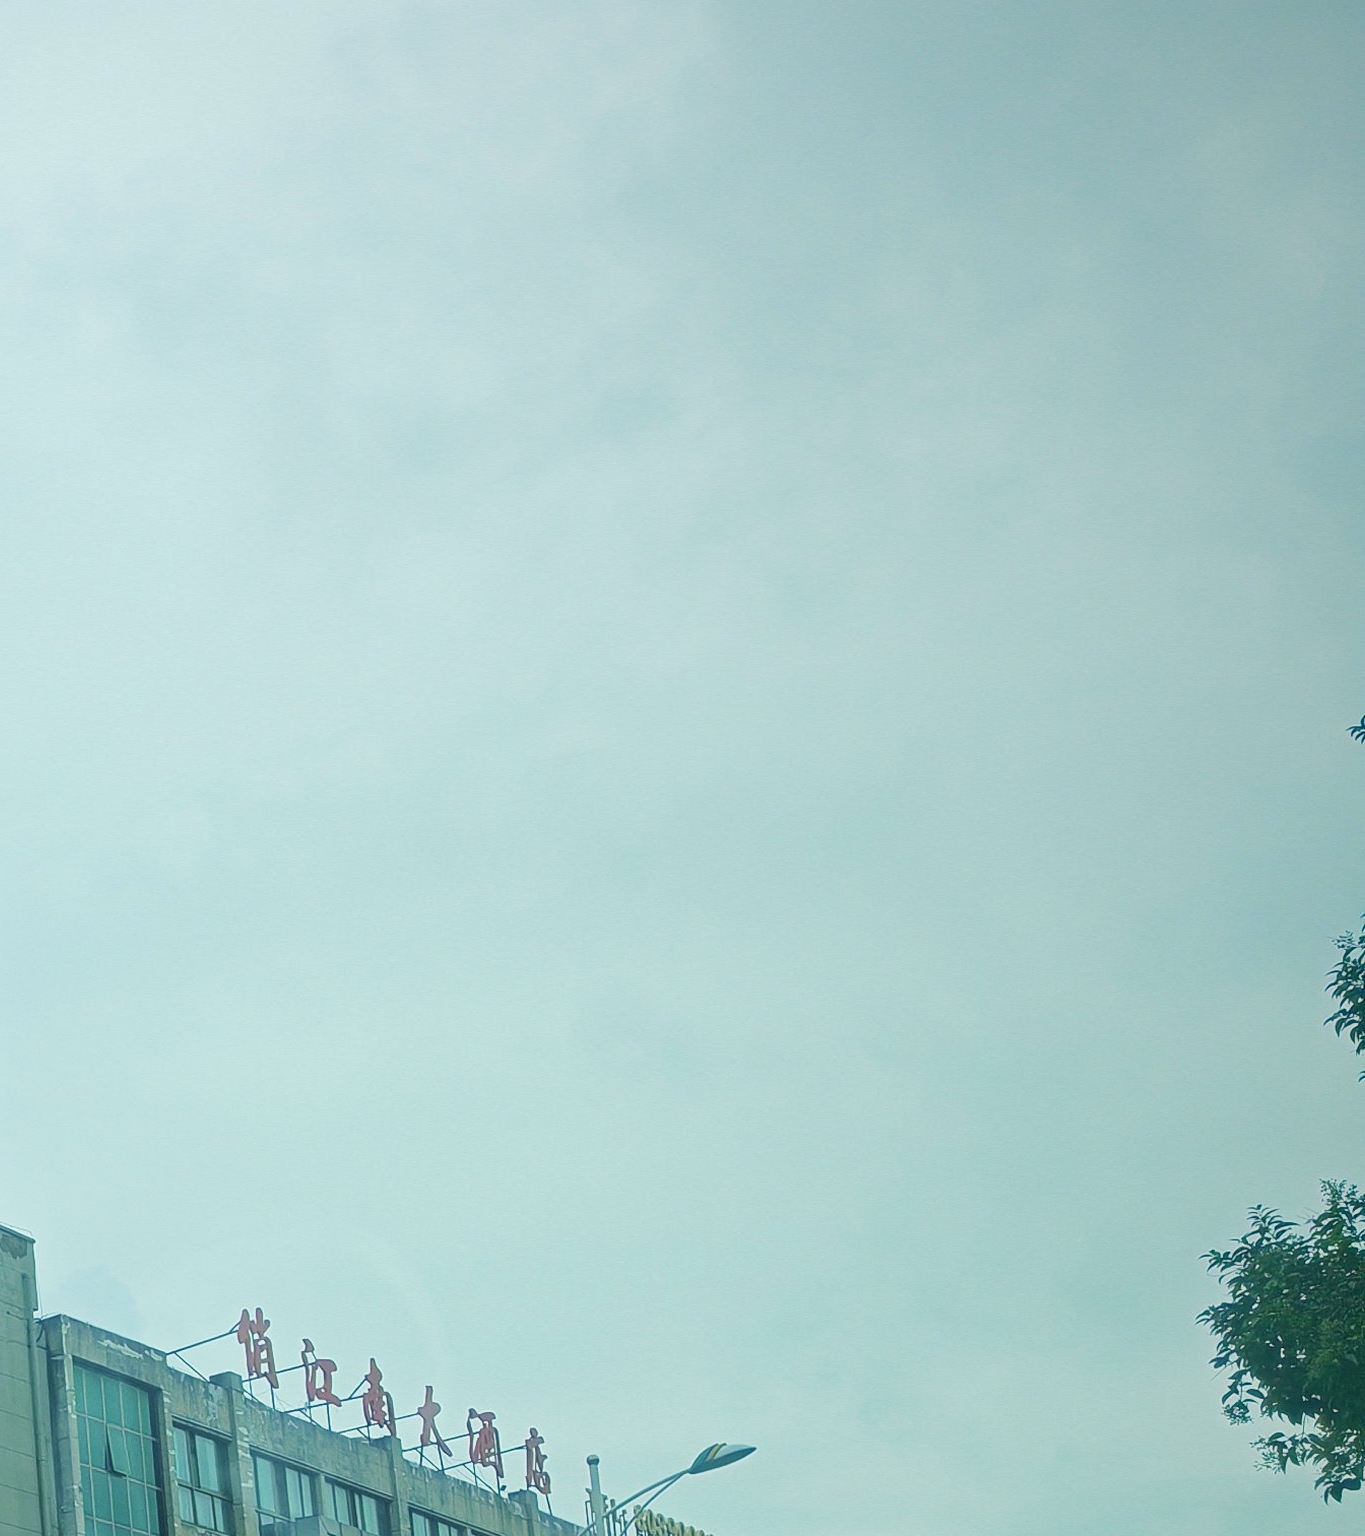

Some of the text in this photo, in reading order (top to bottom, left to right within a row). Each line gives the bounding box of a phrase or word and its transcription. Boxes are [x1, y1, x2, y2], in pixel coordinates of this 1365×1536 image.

[237, 1306, 552, 1495] 俏江南大酒店
